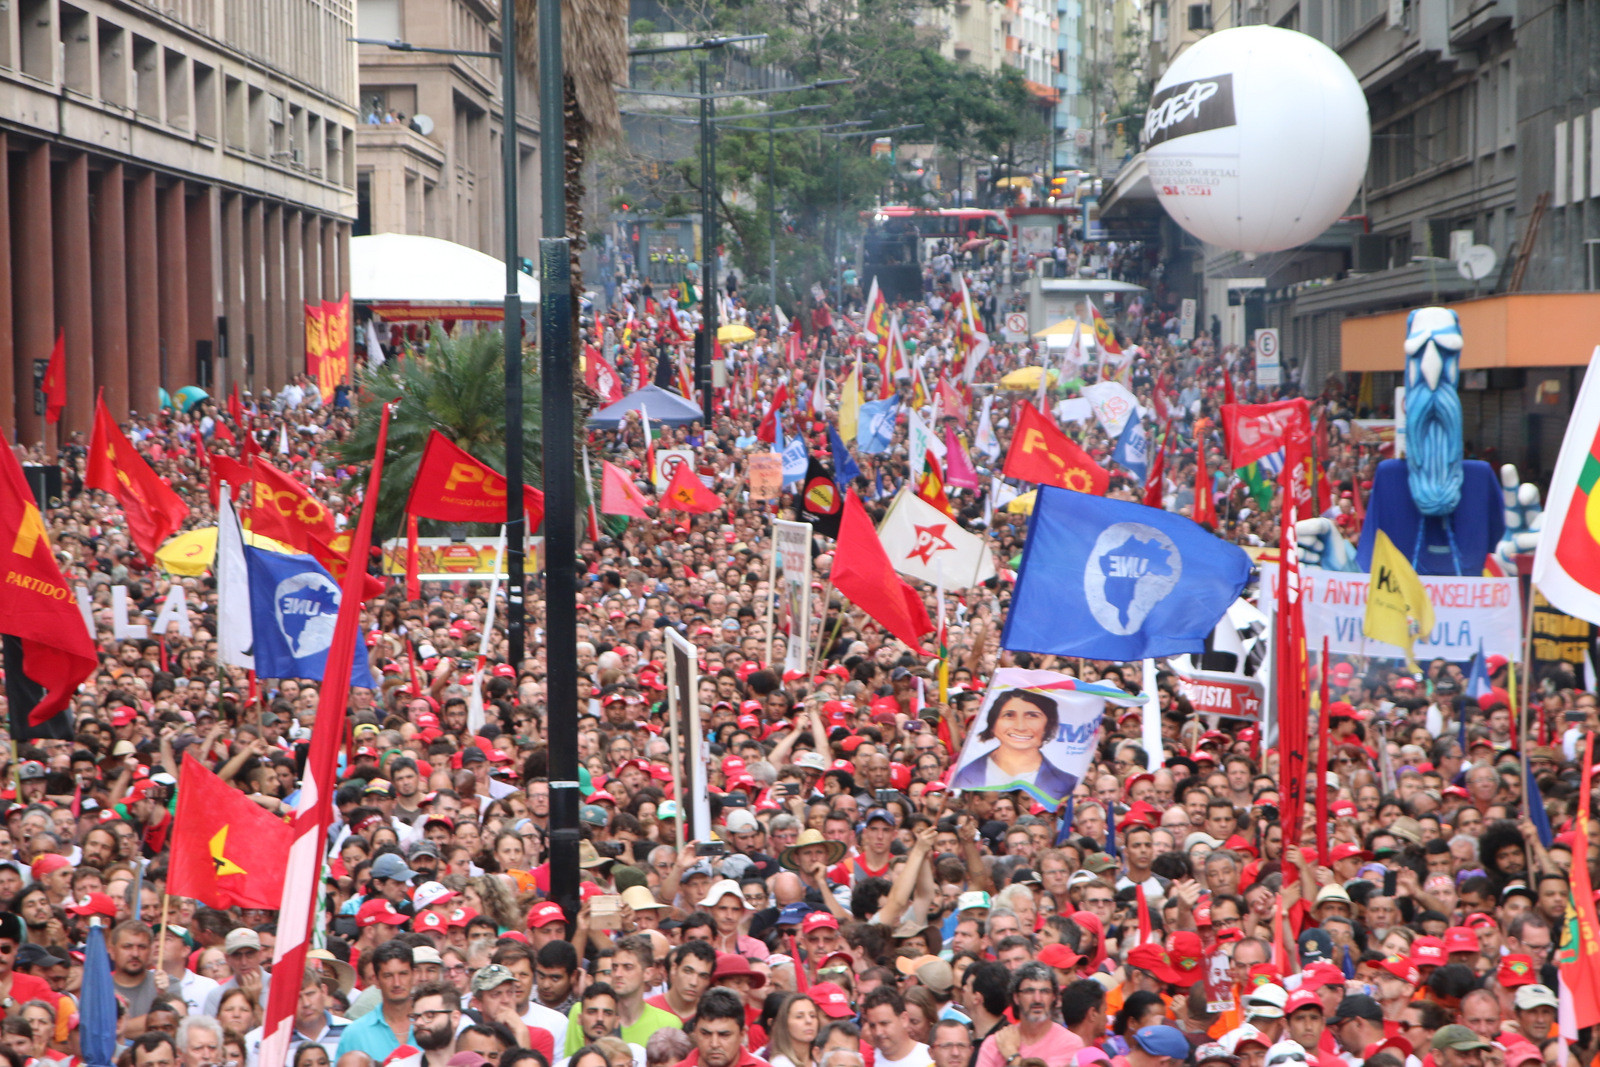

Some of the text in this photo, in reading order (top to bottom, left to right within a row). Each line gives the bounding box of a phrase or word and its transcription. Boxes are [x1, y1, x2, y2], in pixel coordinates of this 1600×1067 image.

[1264, 337, 1271, 351] E
[255, 481, 325, 525] PCO
[917, 531, 946, 556] PT
[5, 571, 67, 600] PARTIDO
[1245, 698, 1258, 711] PT
